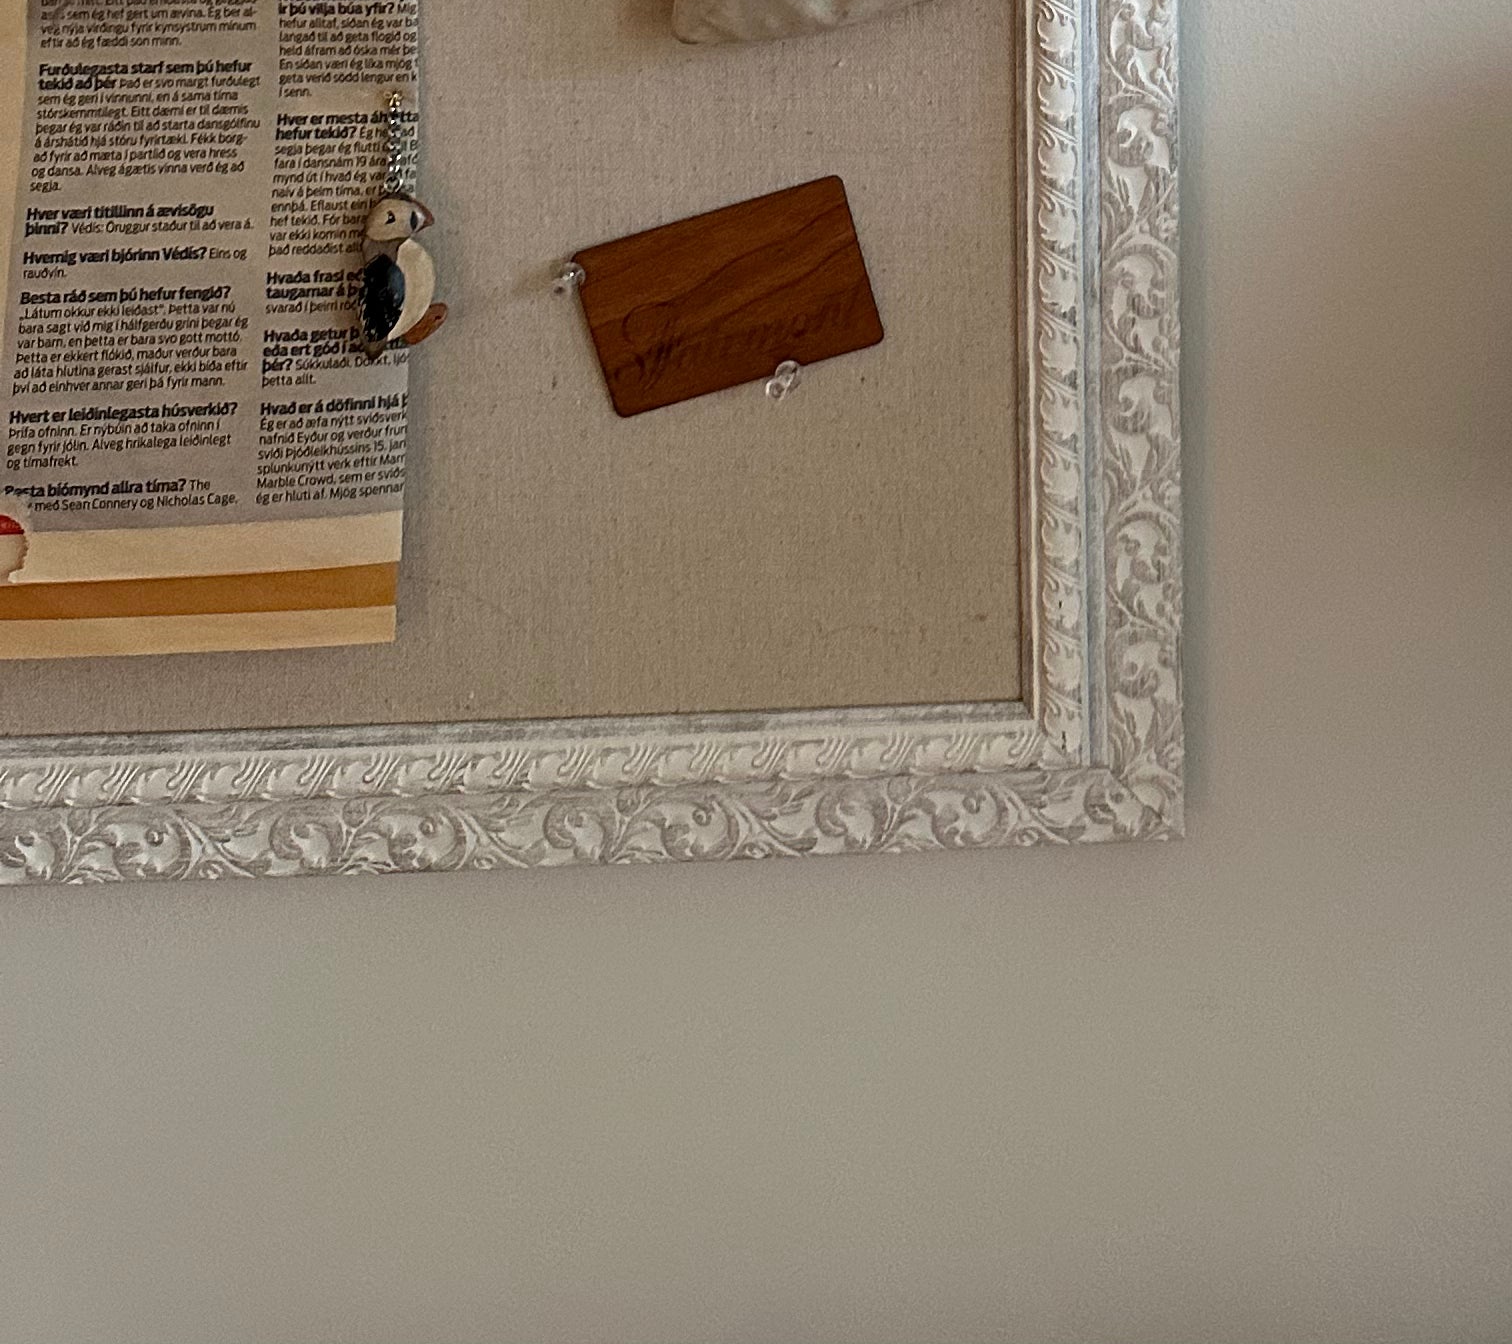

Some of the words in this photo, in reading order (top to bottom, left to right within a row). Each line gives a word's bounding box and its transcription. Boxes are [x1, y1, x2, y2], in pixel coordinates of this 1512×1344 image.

[166, 63, 194, 74] sem
[20, 291, 61, 305] Besta
[88, 291, 118, 304] sem
[9, 408, 50, 424] Hvert
[51, 410, 67, 423] er
[61, 498, 91, 511] Sean
